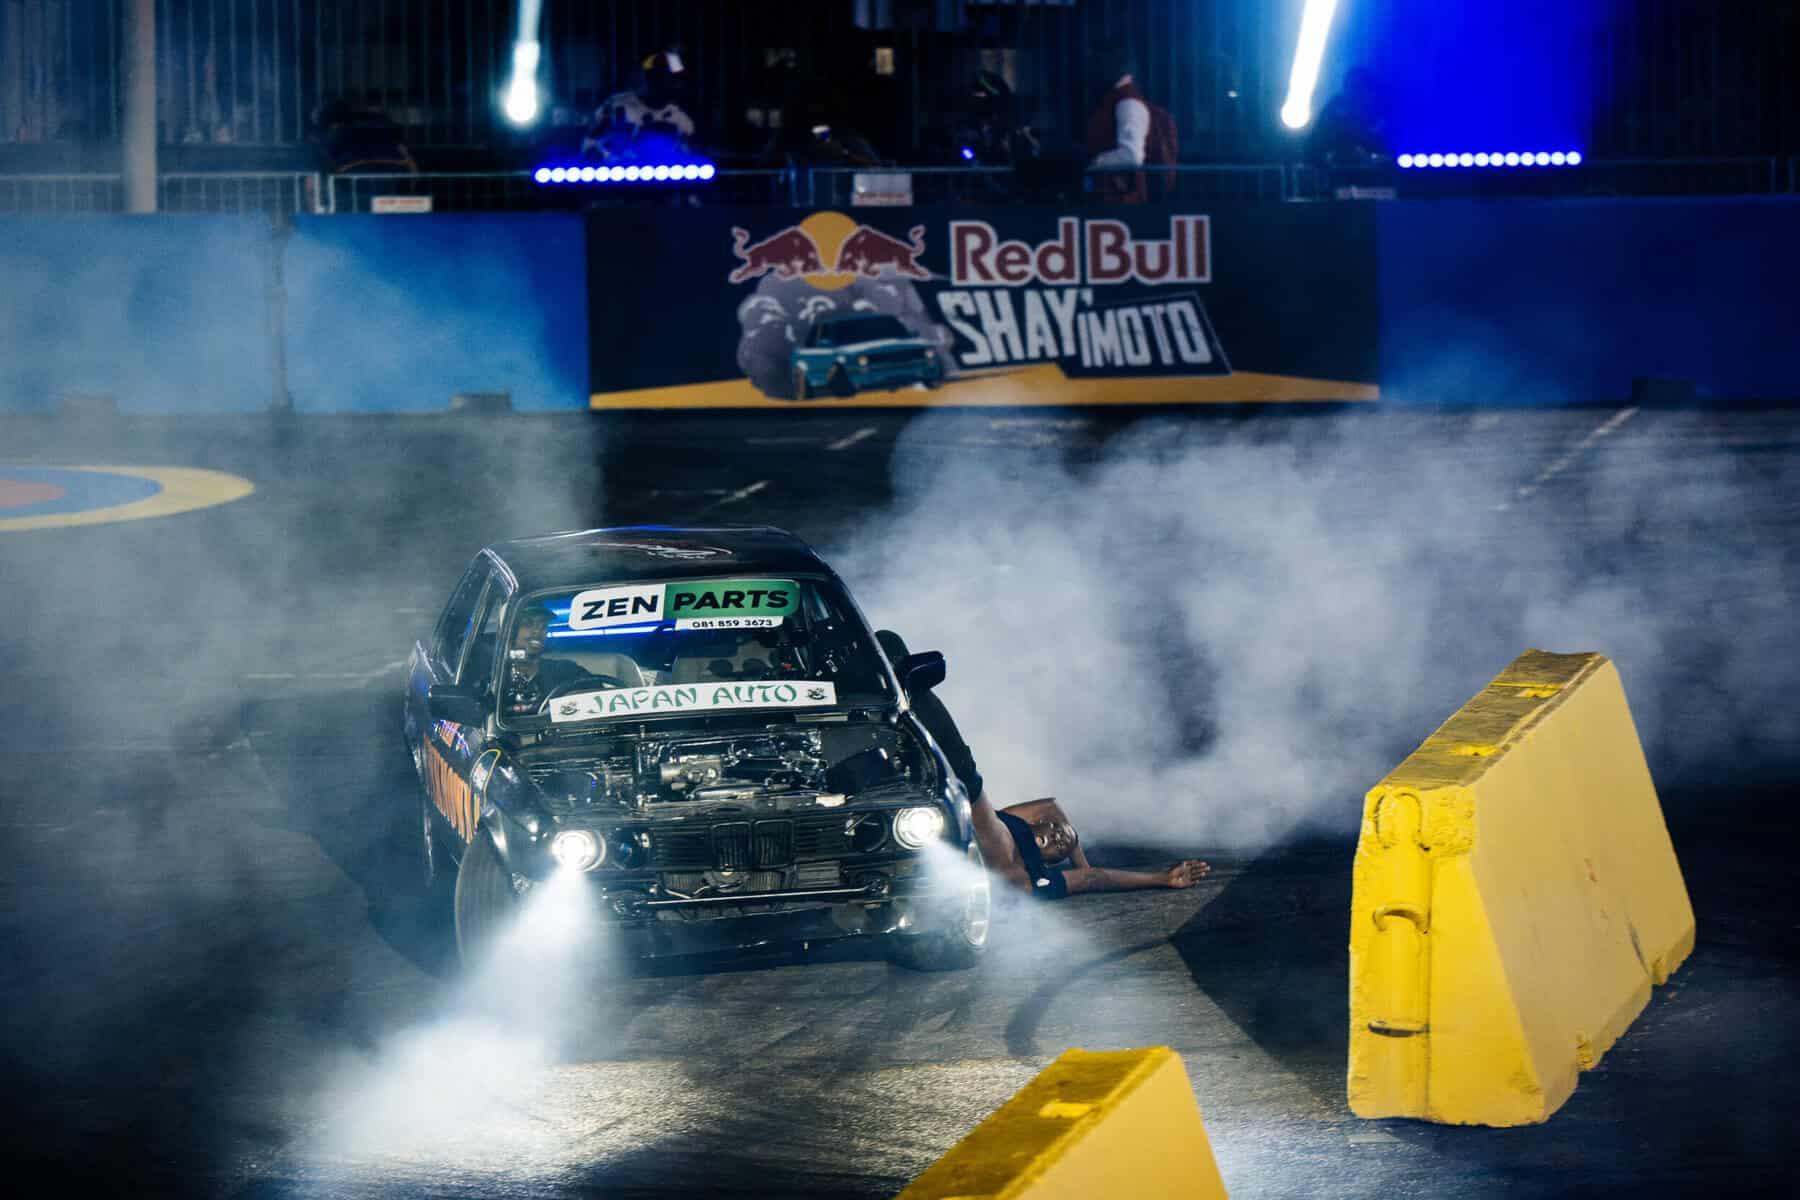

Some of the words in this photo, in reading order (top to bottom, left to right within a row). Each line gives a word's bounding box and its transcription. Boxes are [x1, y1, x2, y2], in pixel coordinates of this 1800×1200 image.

[949, 216, 1080, 286] Red
[1085, 214, 1211, 284] Bull
[581, 595, 659, 621] ZEN
[673, 590, 789, 611] PARTS
[712, 684, 797, 705] AUTO
